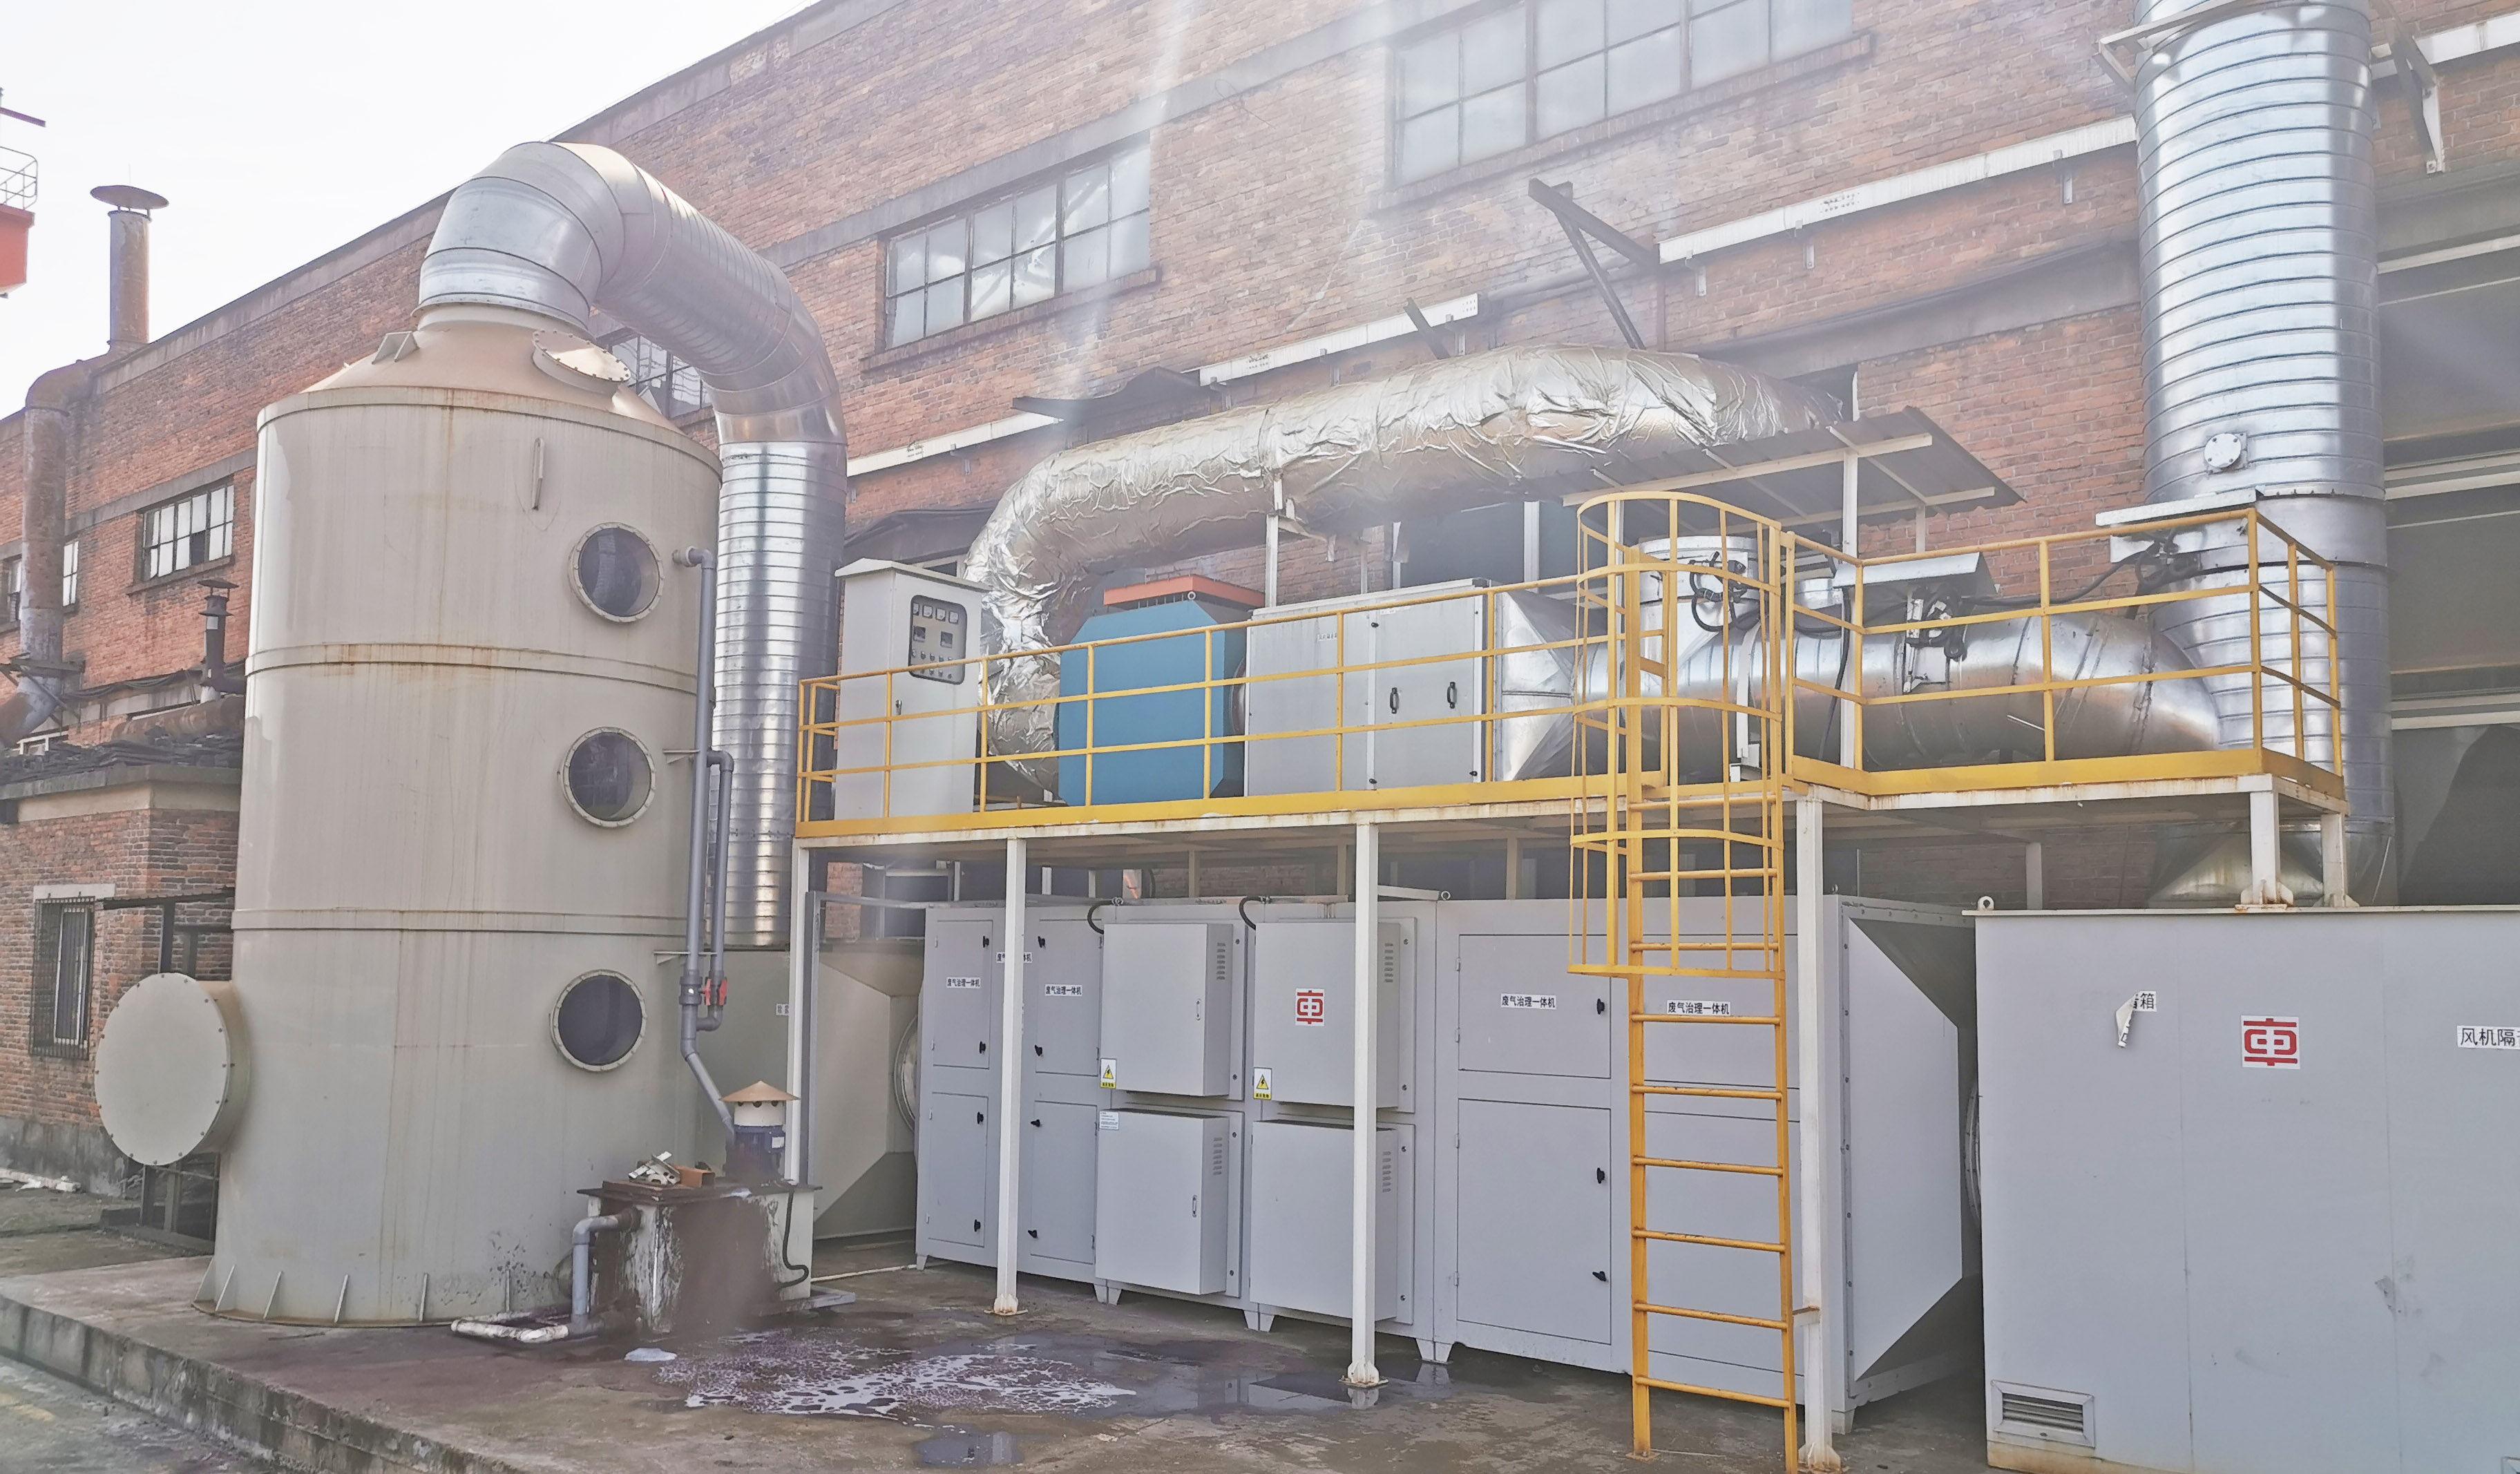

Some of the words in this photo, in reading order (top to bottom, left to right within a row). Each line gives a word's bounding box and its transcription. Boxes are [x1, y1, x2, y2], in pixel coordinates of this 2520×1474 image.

[1502, 995, 1555, 1008] 废气治理一体机
[1668, 1002, 1729, 1015] 废气治理一体机
